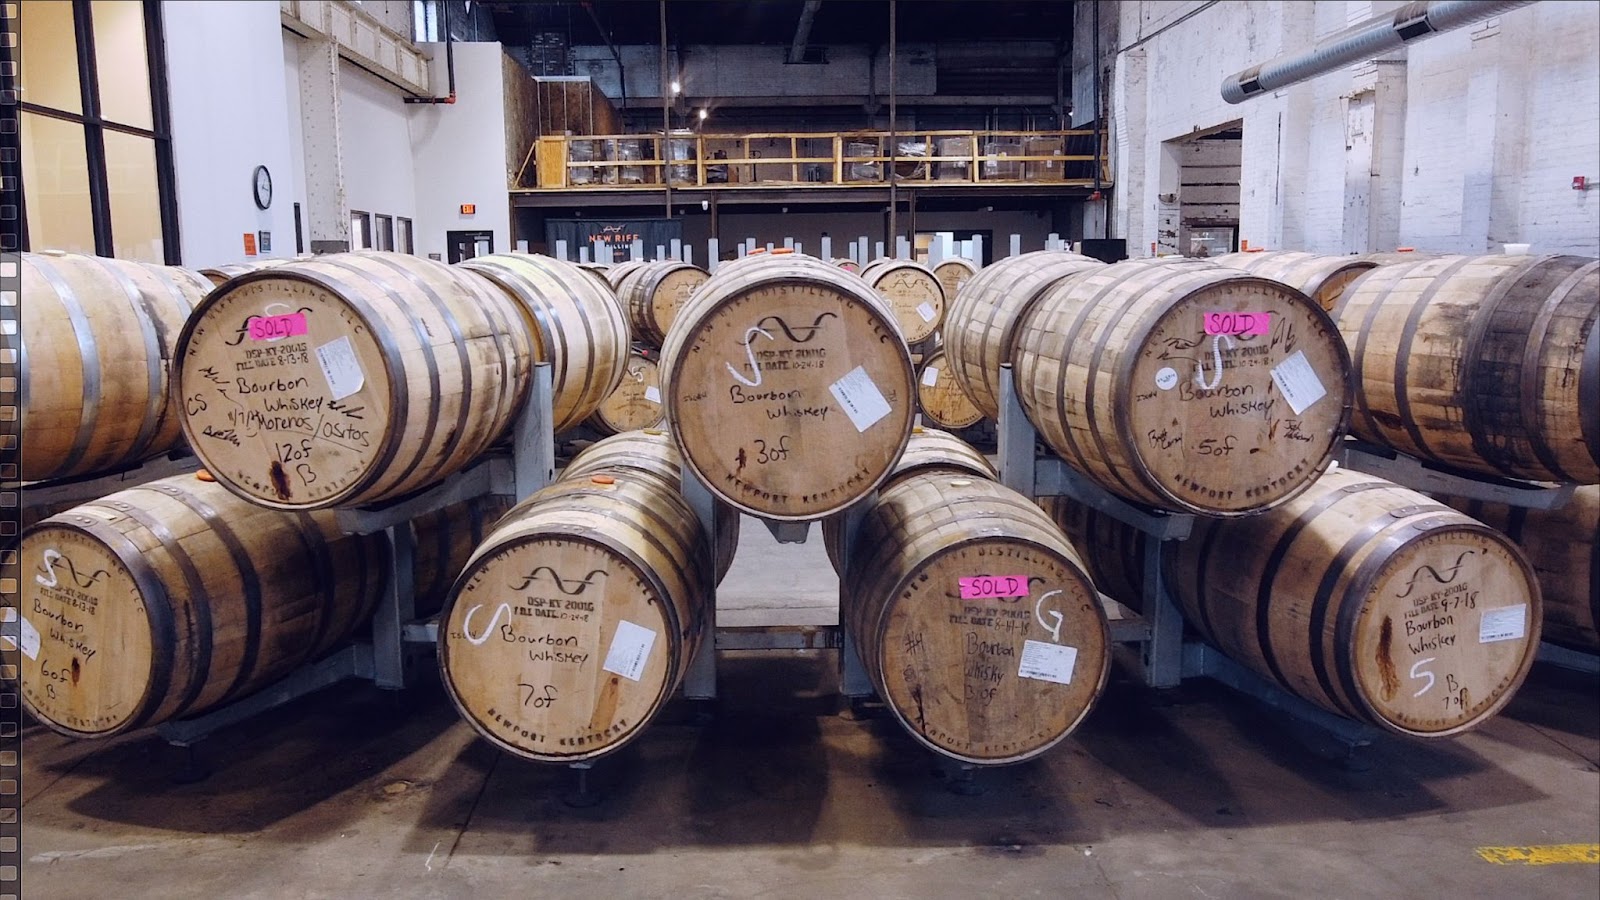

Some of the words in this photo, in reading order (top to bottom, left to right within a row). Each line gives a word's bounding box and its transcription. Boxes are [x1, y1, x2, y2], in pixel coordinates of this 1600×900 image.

[462, 205, 474, 214] EXIT
[588, 235, 611, 243] NEW
[254, 318, 292, 338] SOLD
[340, 309, 364, 334] LLC
[1209, 313, 1256, 334] SOLD
[691, 323, 713, 353] NEW
[867, 317, 889, 344] LLC
[277, 352, 309, 366] 8-13-18
[236, 377, 309, 395] Bourbon
[730, 384, 802, 404] Bourbon
[1179, 381, 1254, 401] Bourbon
[263, 396, 324, 414] Whiskey
[766, 405, 828, 421] Whiskey
[1209, 399, 1274, 419] Whiskey
[296, 463, 317, 487] B
[1174, 473, 1234, 500] NEWPORT
[466, 566, 490, 592] NEW
[971, 577, 1019, 597] SOLD
[1441, 591, 1480, 612] 9-7-18
[34, 598, 84, 633] Bourbon
[1405, 614, 1454, 637] Bourbon
[500, 624, 578, 647] Bourbon
[966, 631, 1015, 658] Bourbon
[1409, 634, 1456, 655] Whiskey
[50, 628, 96, 665] Whiskey
[529, 650, 589, 671] Whiskey
[1446, 673, 1459, 694] B
[487, 707, 546, 743] NEWPORT
[559, 718, 628, 746] KENTUCKY
